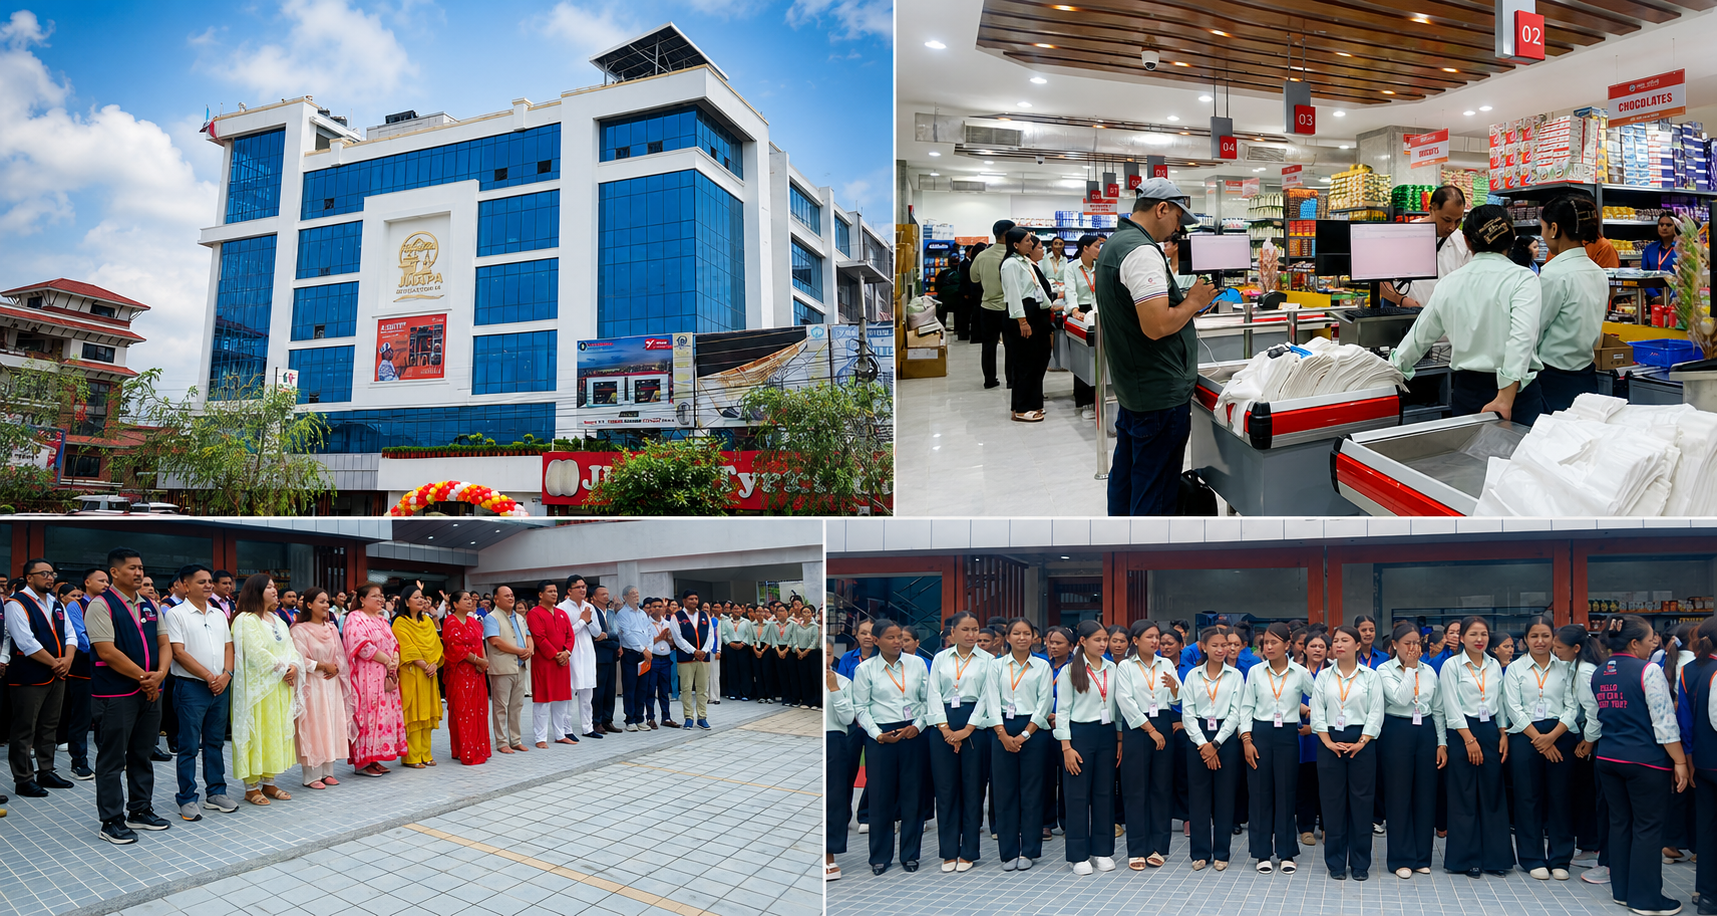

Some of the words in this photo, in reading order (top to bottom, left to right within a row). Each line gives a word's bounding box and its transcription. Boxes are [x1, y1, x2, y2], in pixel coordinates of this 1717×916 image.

[1522, 25, 1541, 45] 02
[1618, 92, 1673, 113] CHOCOLATES
[1298, 113, 1313, 126] 03
[1222, 142, 1235, 152] 04
